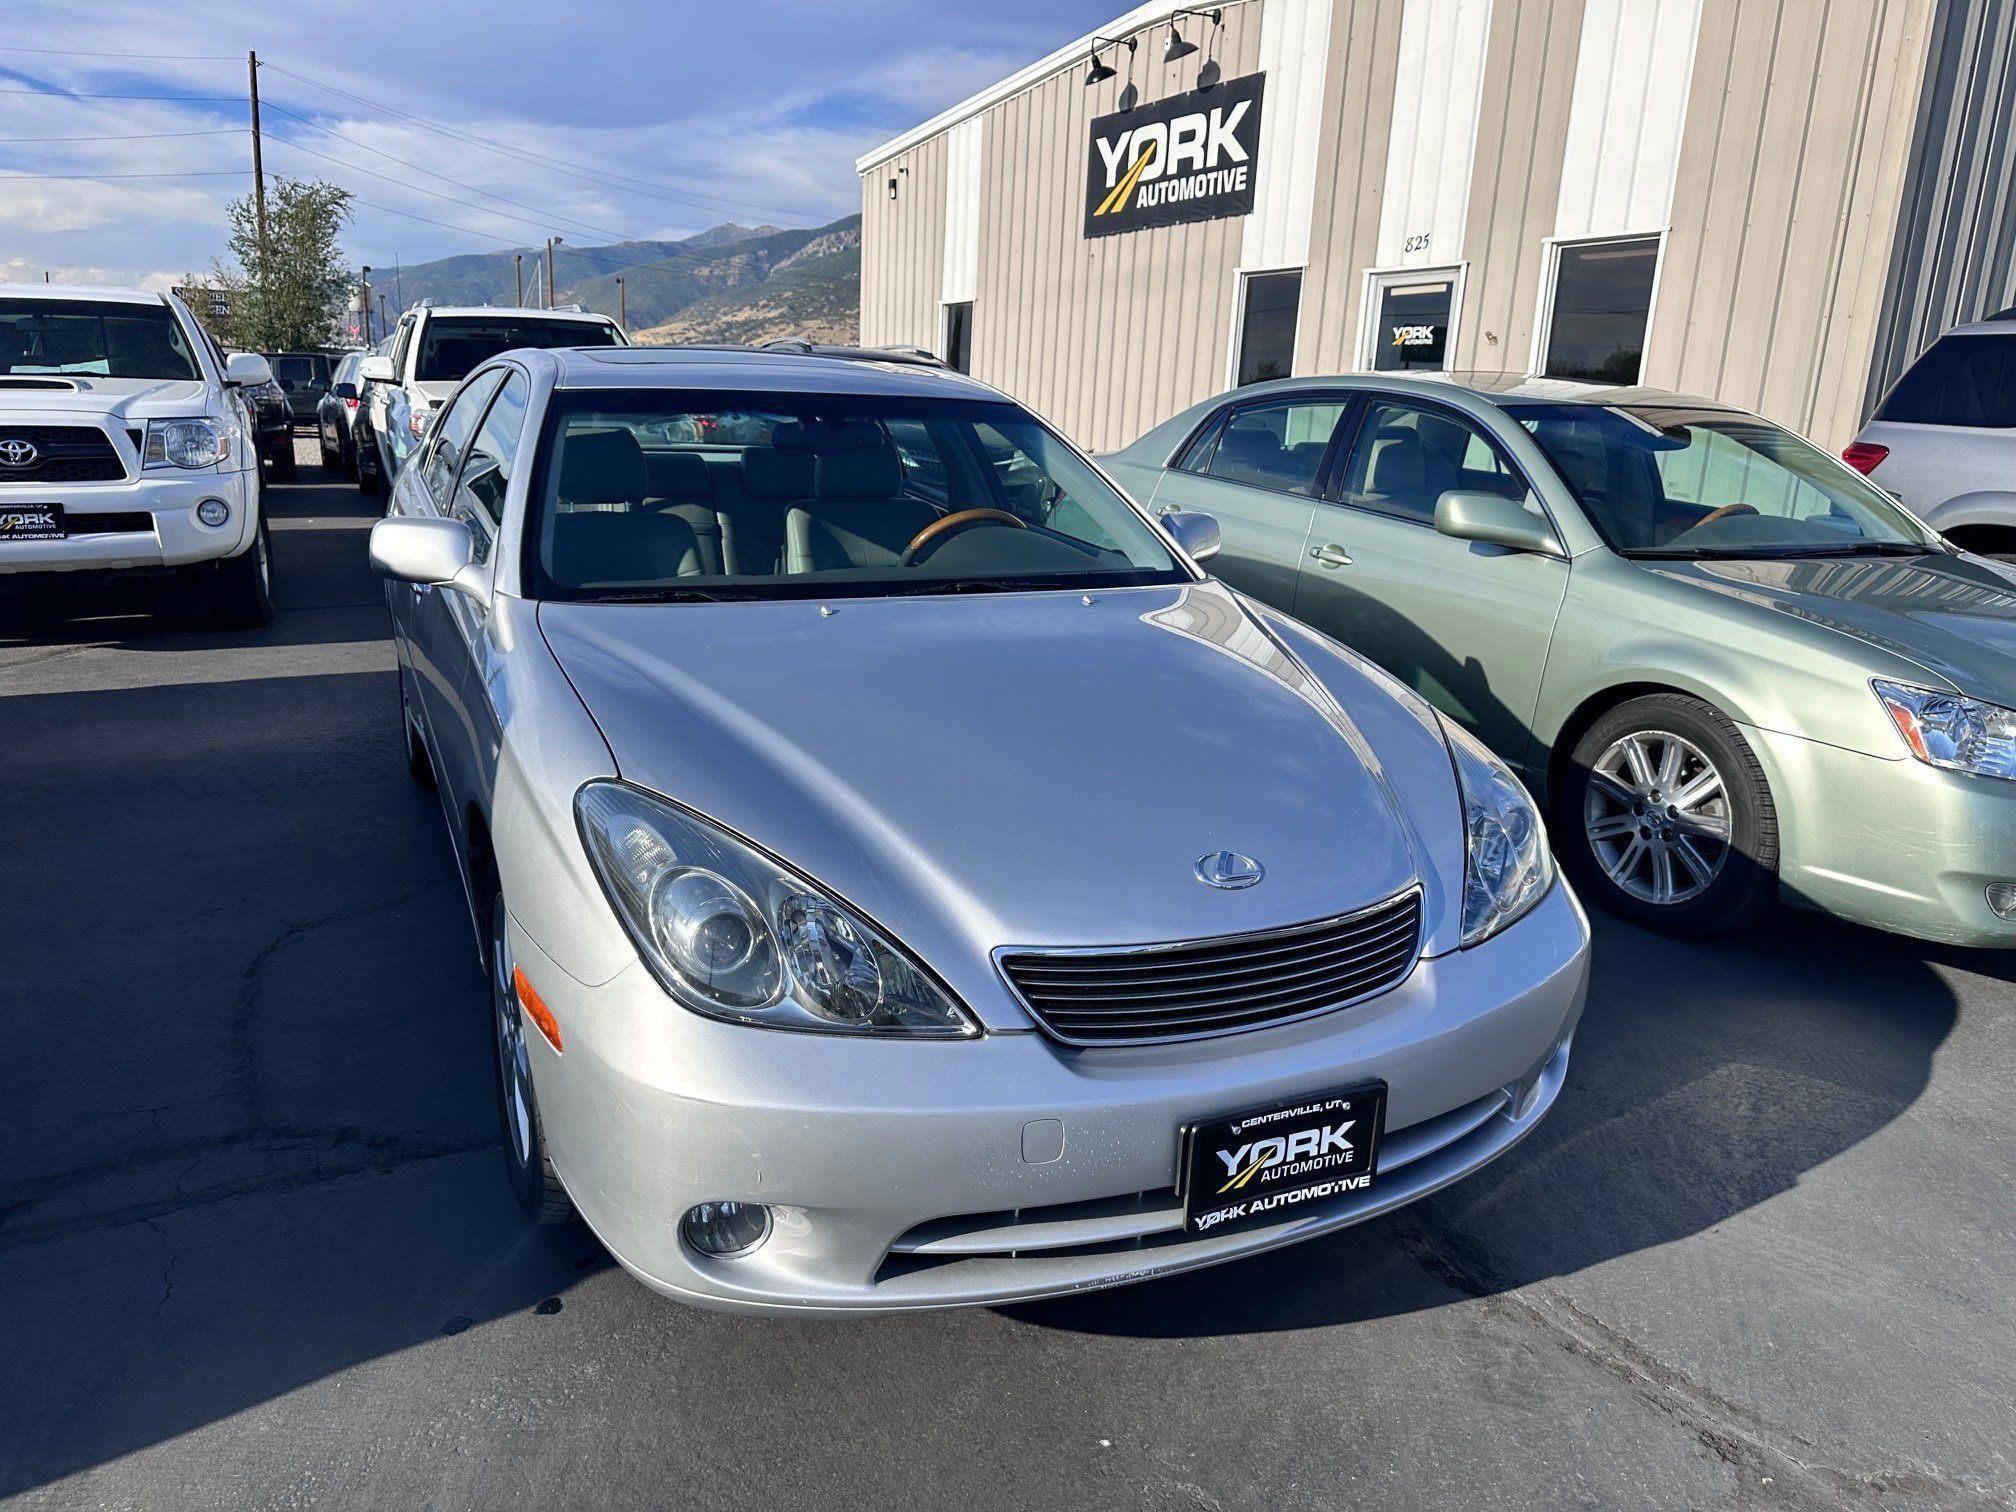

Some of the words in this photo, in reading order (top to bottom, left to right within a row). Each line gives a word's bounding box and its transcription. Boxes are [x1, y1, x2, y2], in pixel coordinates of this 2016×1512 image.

[1096, 100, 1252, 188] YORK
[1136, 166, 1248, 208] AUTOMOTIVE
[1405, 233, 1430, 253] 825
[1392, 325, 1434, 339] YORK
[1241, 1104, 1323, 1128] CENTERVILLE,
[1325, 1100, 1342, 1110] UT
[1216, 1120, 1356, 1177] YORK
[1261, 1150, 1354, 1183] AUTOMOTIVE
[1194, 1203, 1247, 1231] YORK
[1250, 1175, 1371, 1213] AUTOMOTIVE
